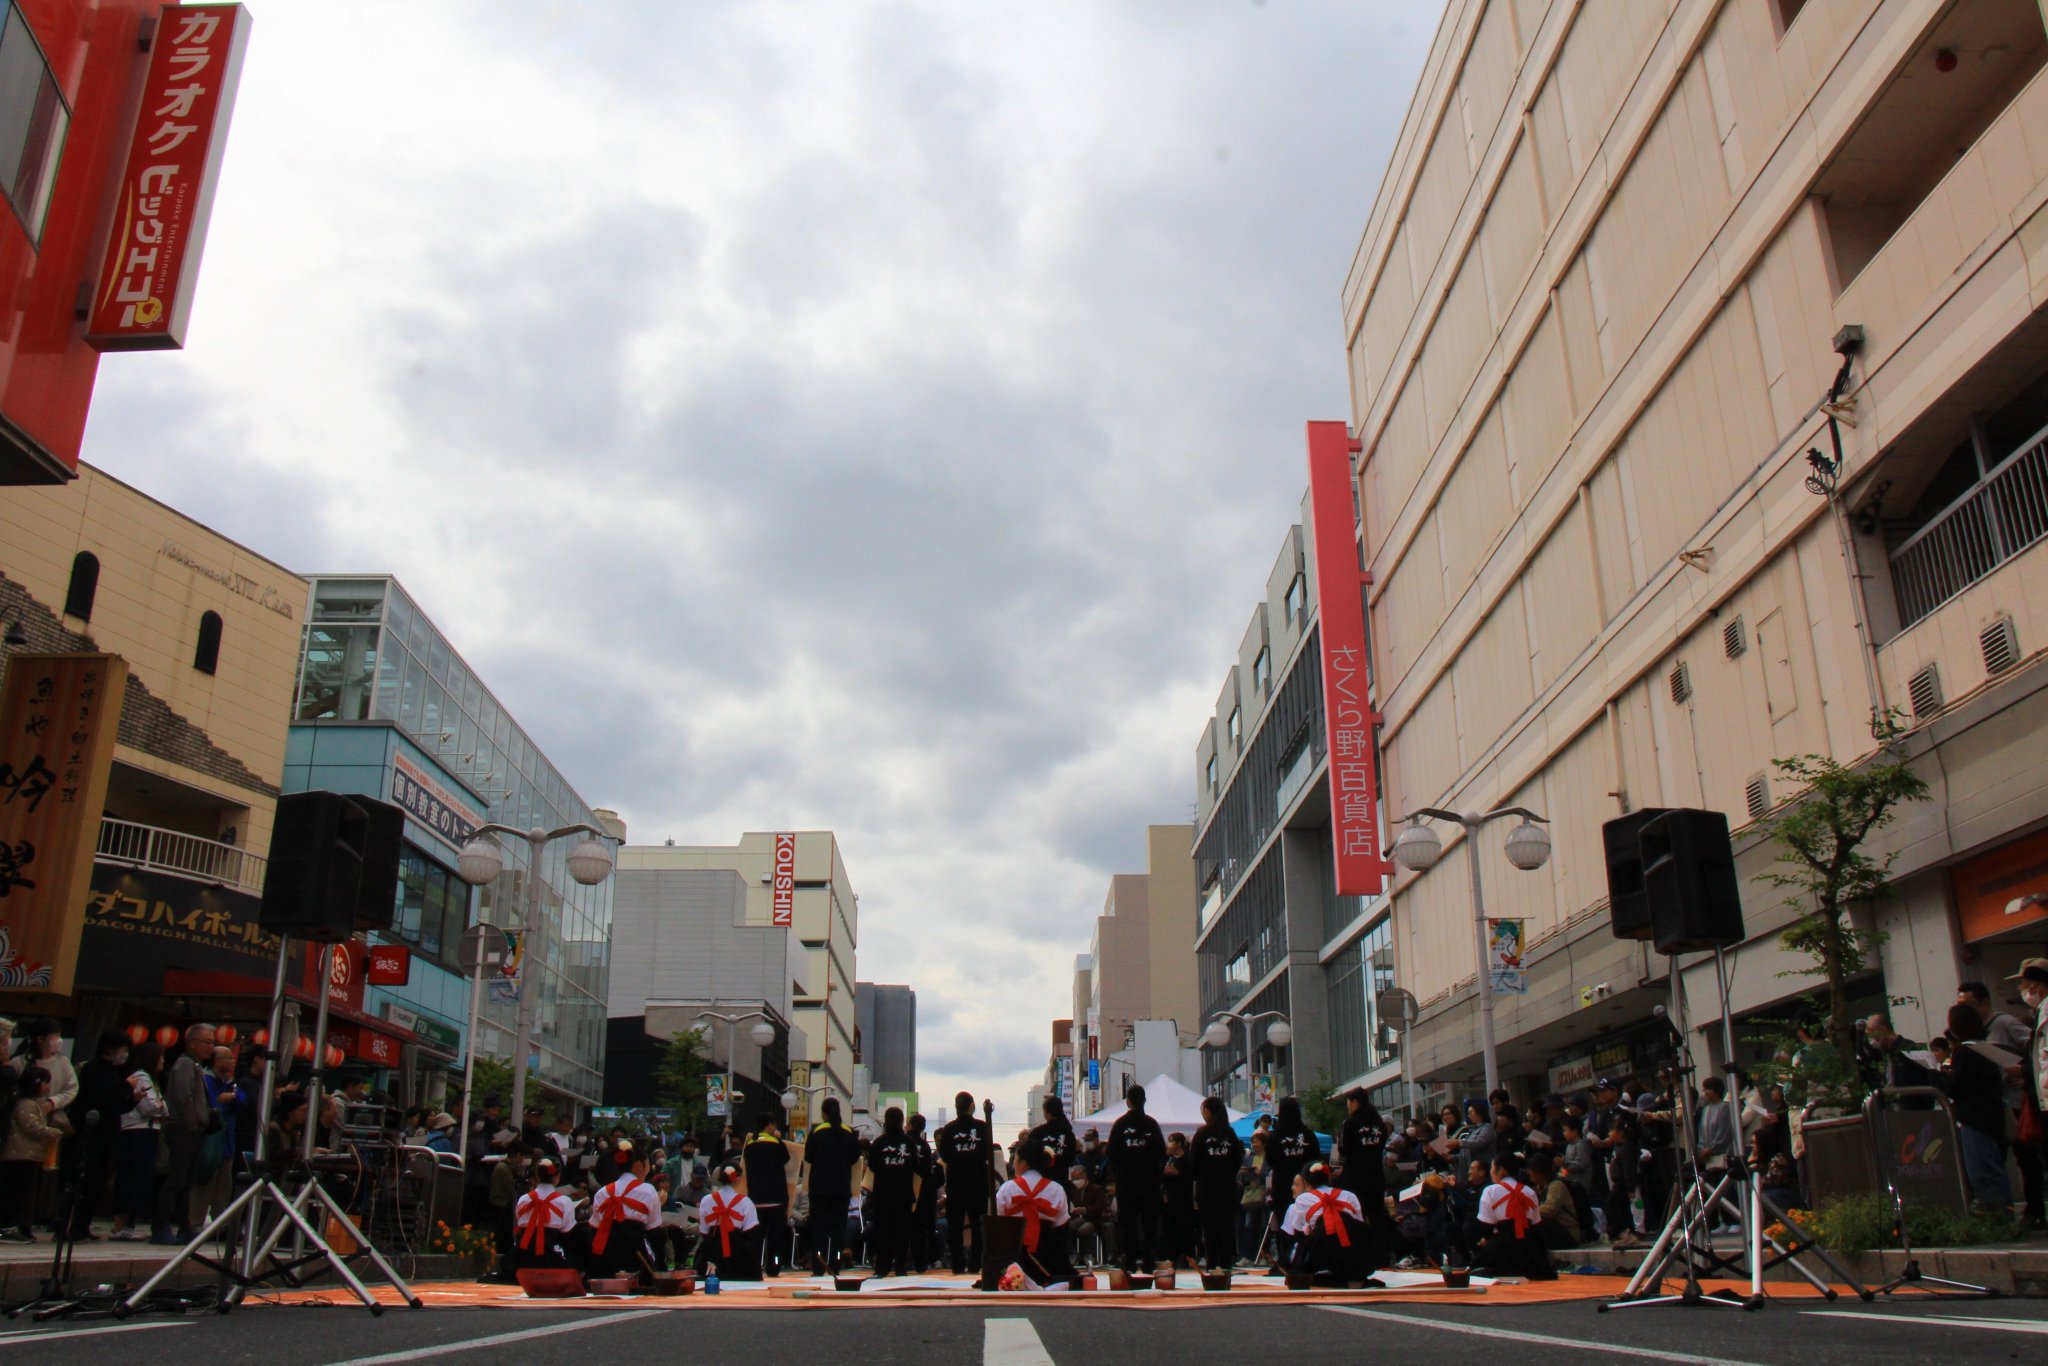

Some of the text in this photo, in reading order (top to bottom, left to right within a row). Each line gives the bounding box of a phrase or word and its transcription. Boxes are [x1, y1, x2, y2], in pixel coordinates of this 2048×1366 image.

[115, 12, 221, 328] カラオケ ビッグエコー
[157, 182, 189, 295] Karaoke Entertainment
[1331, 645, 1373, 857] さくら野百貨店
[394, 773, 480, 849] 個別教室のトラ
[774, 833, 794, 923] KOUSHIN
[141, 925, 187, 940] HIGH
[192, 934, 231, 949] BALL
